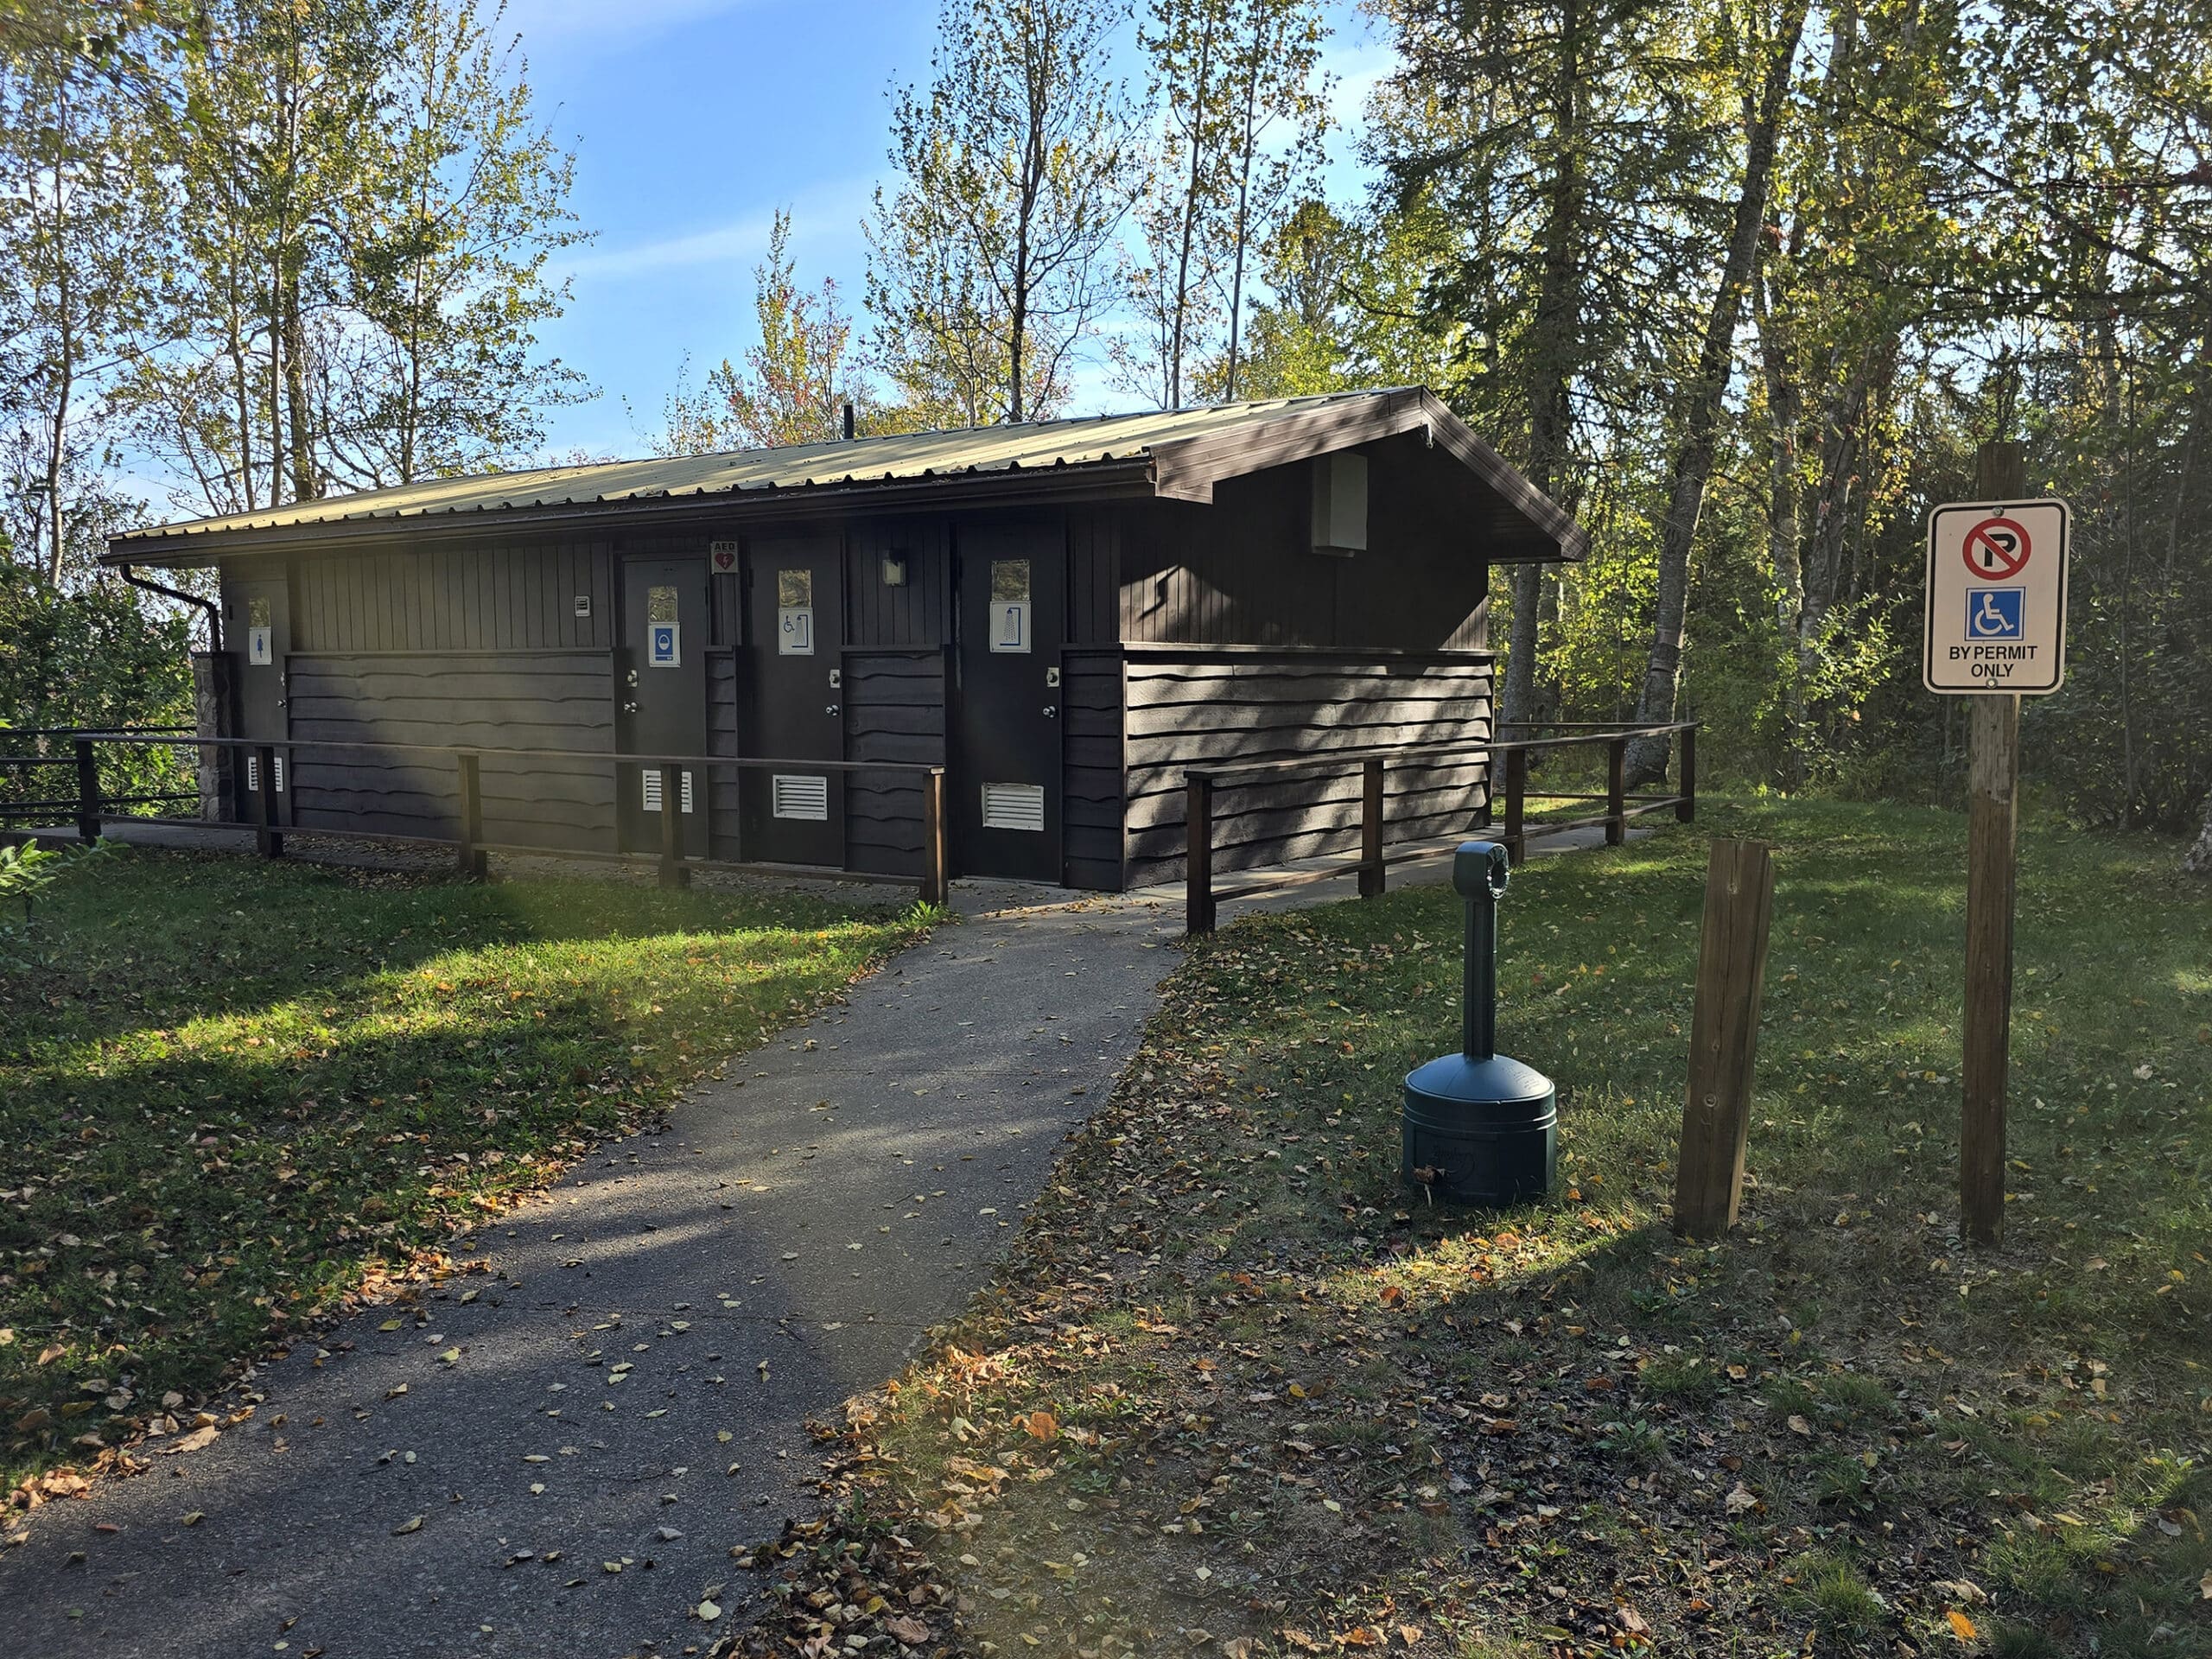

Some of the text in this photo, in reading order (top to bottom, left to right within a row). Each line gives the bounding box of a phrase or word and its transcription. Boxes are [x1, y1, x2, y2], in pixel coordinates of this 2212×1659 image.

[1949, 645, 2037, 660] BY PERMIT
[1971, 664, 2014, 677] ONLY
